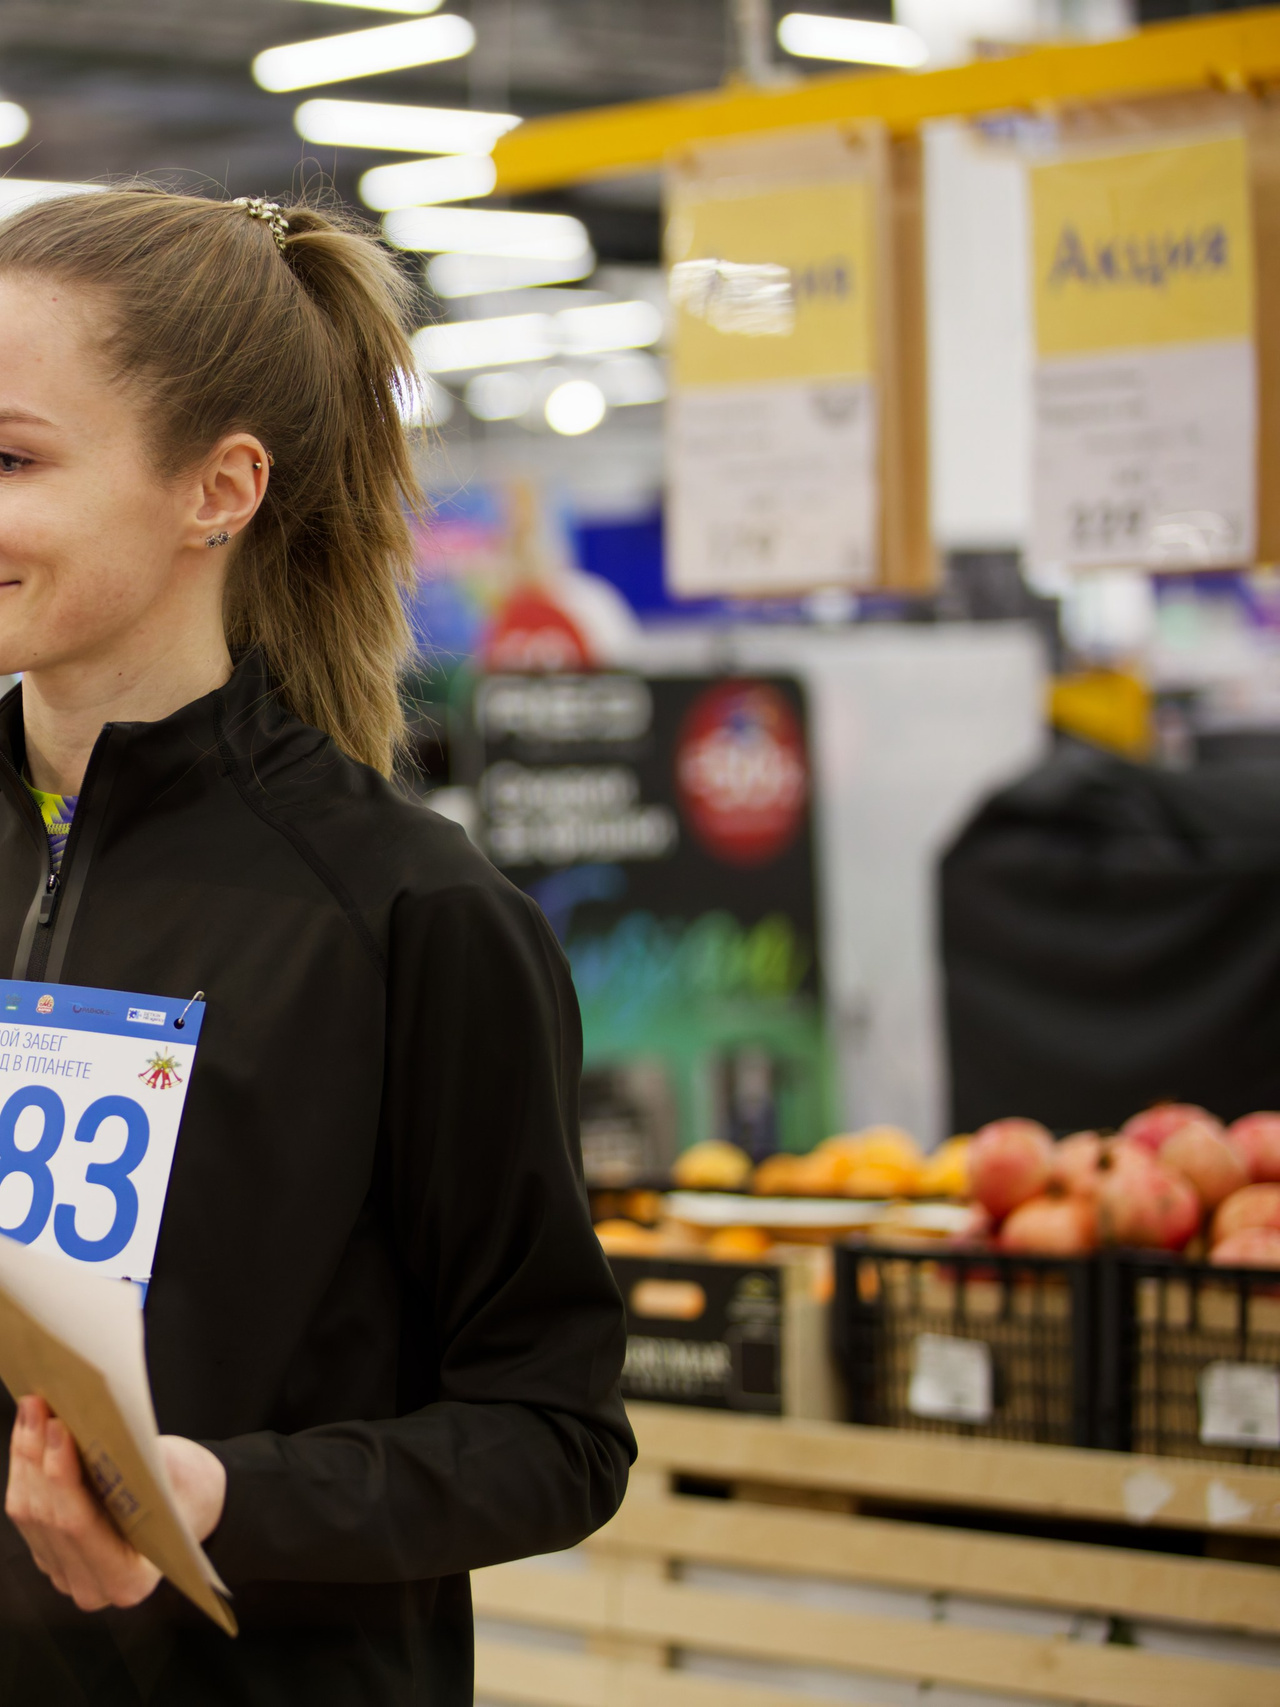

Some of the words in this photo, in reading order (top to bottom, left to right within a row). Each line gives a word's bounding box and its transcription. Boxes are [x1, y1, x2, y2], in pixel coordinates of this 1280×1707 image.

[23, 1032, 68, 1051] ЗАБЕГ
[13, 1055, 23, 1071] В
[25, 1056, 93, 1079] ПЛАНЕТЕ
